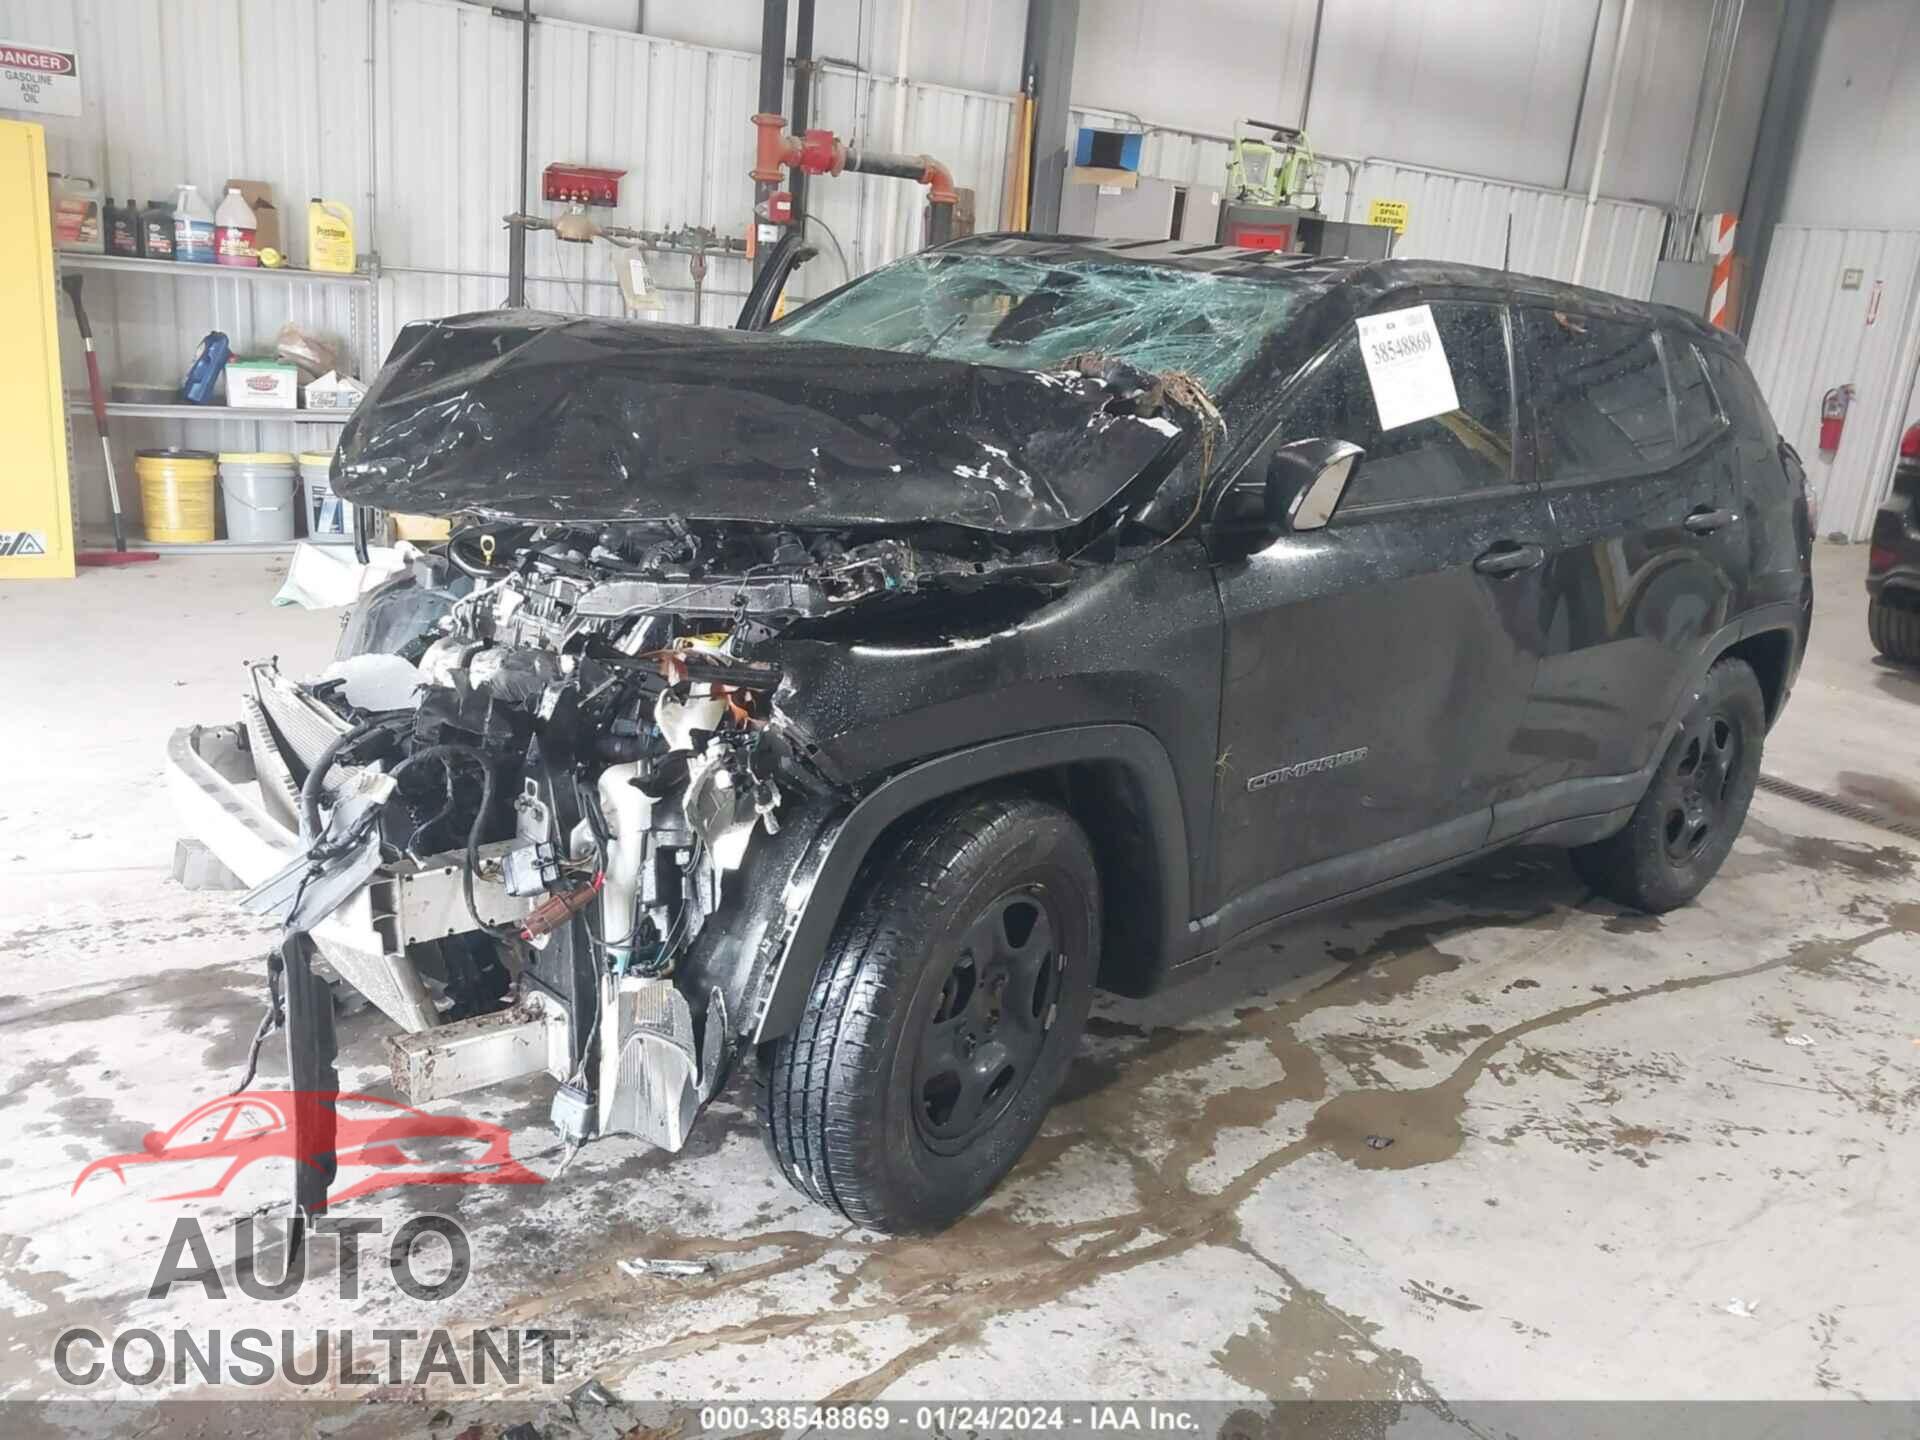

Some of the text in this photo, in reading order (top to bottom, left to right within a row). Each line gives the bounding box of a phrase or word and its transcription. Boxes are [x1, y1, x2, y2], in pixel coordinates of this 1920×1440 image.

[5, 70, 53, 86] GASOLINE
[21, 83, 40, 93] AND
[24, 93, 39, 104] OIL
[1371, 331, 1432, 365] 38548869
